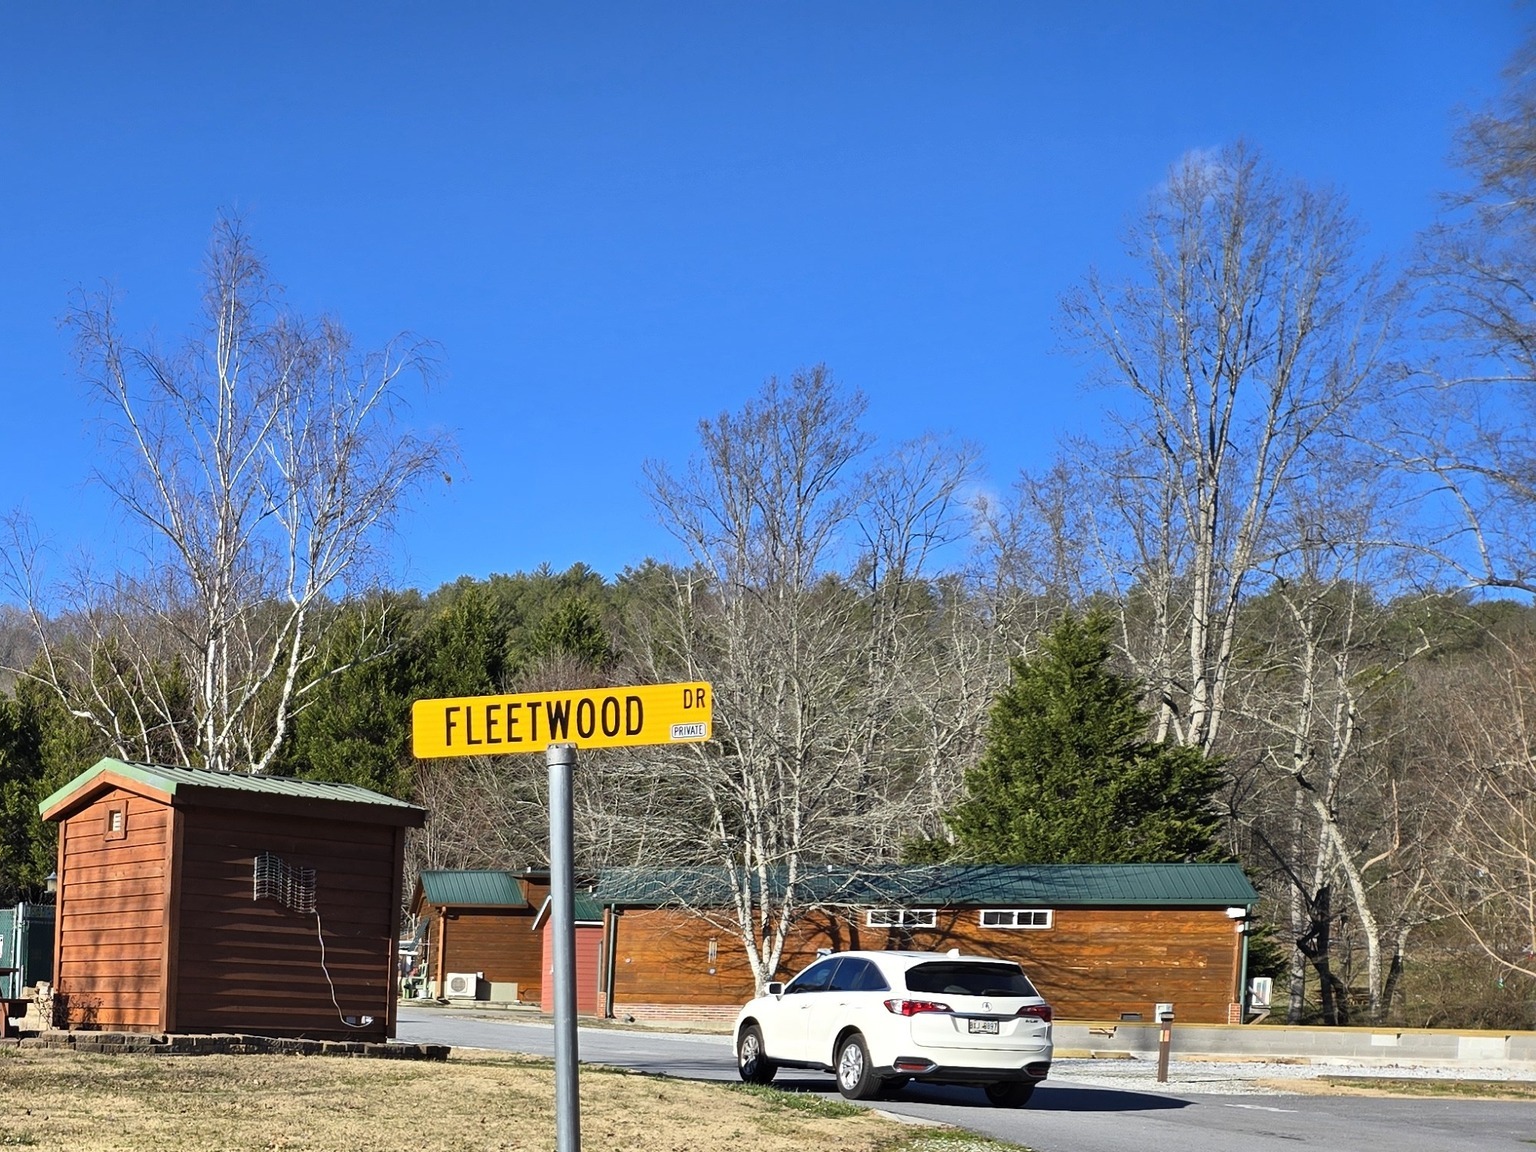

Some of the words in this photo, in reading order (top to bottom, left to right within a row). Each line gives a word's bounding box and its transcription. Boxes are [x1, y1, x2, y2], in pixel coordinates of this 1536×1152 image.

[445, 696, 643, 746] FLEETWOOD
[683, 688, 705, 709] DR
[674, 724, 704, 737] PRIVATE
